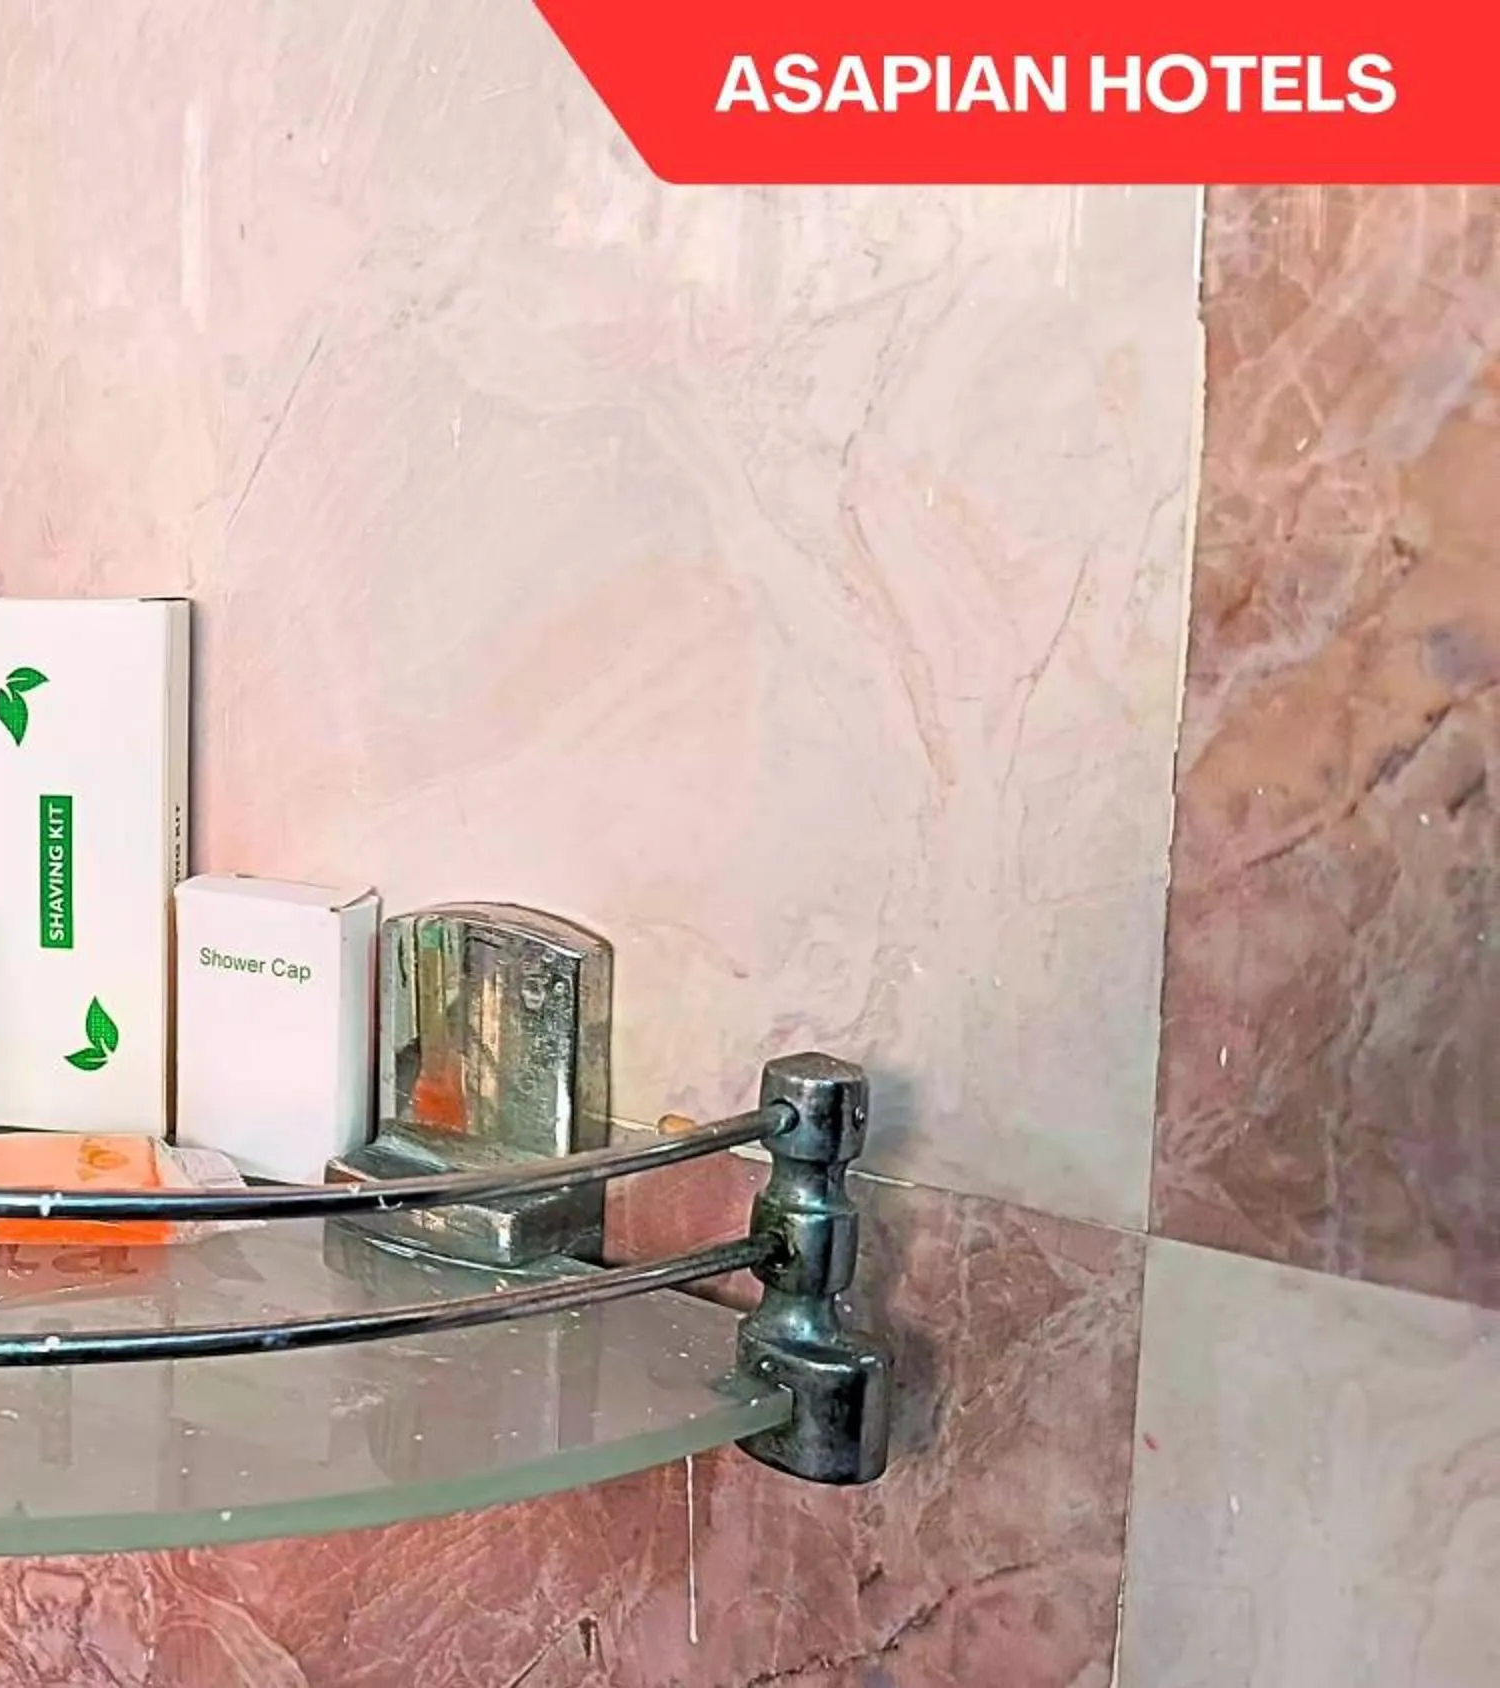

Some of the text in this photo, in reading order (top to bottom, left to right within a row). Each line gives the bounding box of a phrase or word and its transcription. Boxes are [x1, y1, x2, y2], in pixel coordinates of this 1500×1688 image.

[48, 802, 65, 942] SHAVING KIT
[199, 946, 312, 983] Shower Cap
